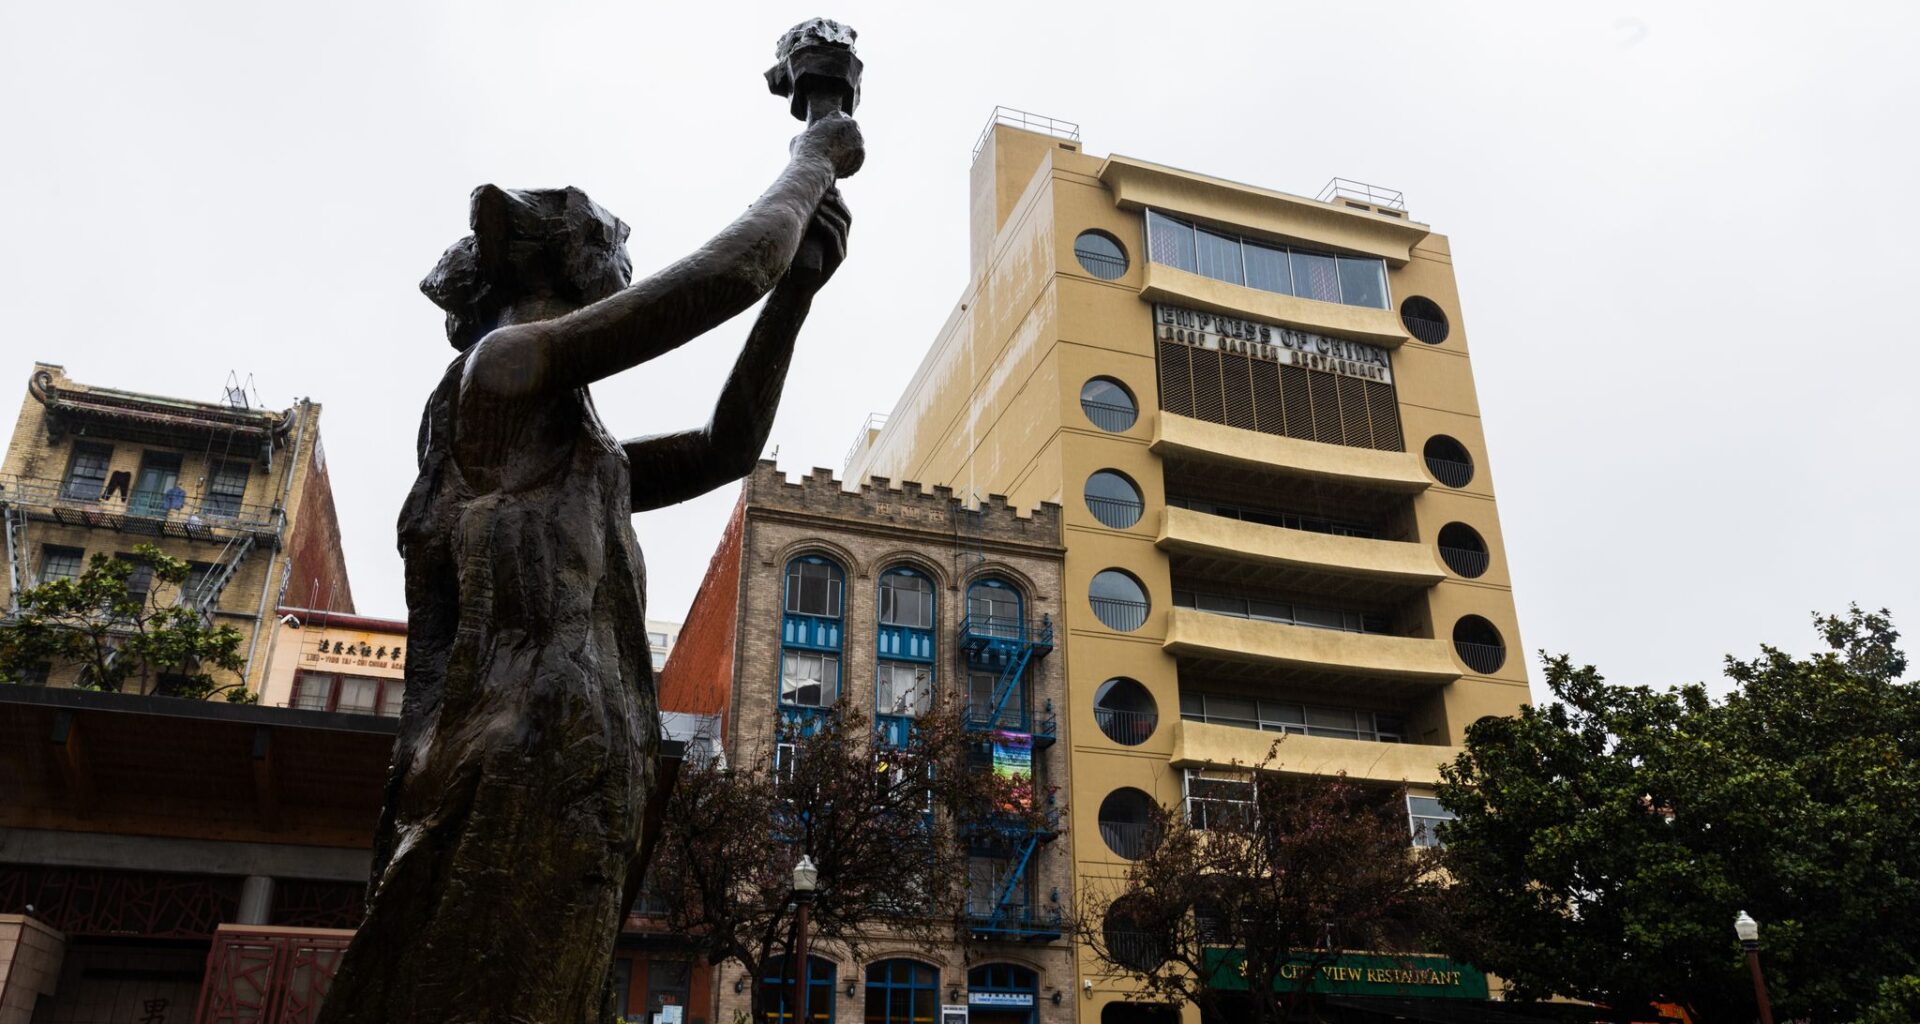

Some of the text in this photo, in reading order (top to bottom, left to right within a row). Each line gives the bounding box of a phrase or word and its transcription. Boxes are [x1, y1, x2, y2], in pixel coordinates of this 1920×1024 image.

[1160, 305, 1387, 367] EMPRESS OF CHINA
[1165, 327, 1385, 380] ROOF GARDEN RESTAURANT
[1321, 965, 1363, 982] VIEW
